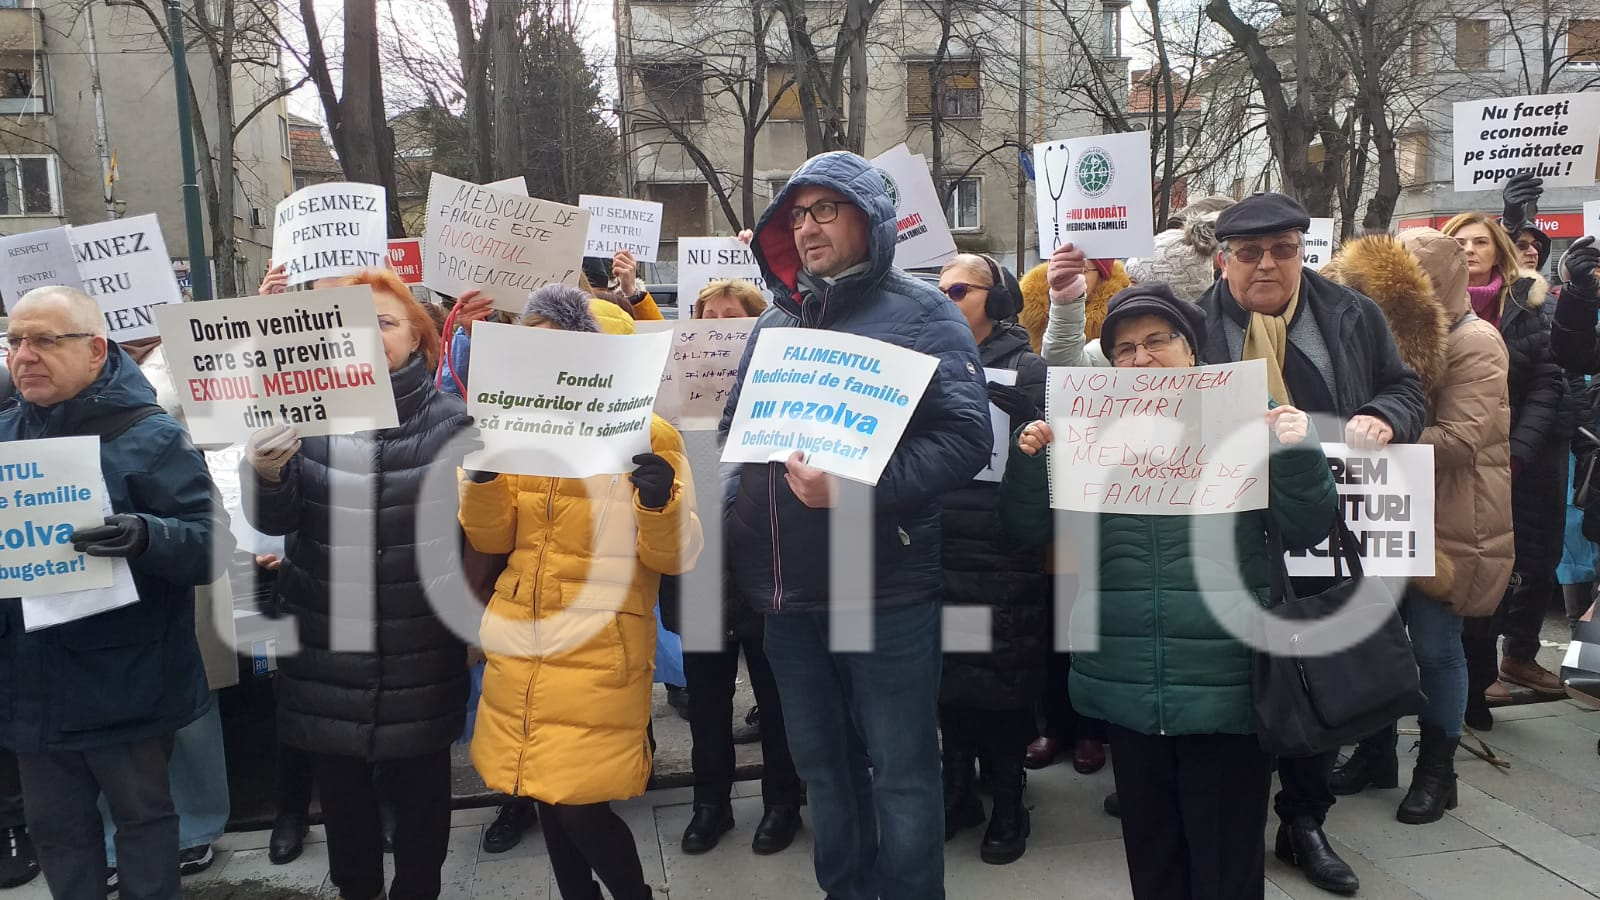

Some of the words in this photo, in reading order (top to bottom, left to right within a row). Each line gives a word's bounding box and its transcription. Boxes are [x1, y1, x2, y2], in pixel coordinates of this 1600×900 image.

[1481, 105, 1509, 121] Nu
[1480, 121, 1569, 141] economie
[1463, 149, 1484, 165] pe
[1489, 142, 1584, 160] sănătatea
[1473, 162, 1561, 185] poporului
[1564, 161, 1573, 176] !
[278, 205, 296, 227] NU
[298, 194, 378, 217] SEMNEZ
[451, 184, 546, 224] MEDICUL
[553, 208, 579, 227] DE
[588, 206, 604, 217] NU
[607, 207, 655, 223] SEMNEZ
[1066, 208, 1083, 220] #NU
[292, 221, 361, 245] PENTRU
[440, 205, 500, 231] FAMILIE
[511, 223, 552, 242] ESTE
[600, 223, 642, 237] PENTRU
[1066, 222, 1097, 231] MEDICINA
[1098, 221, 1128, 231] FAMILIEI
[1535, 218, 1559, 231] tive
[8, 242, 50, 258] RESPECT
[73, 232, 152, 263] MNEZ
[438, 224, 532, 265] AVOCATUL
[587, 239, 651, 256] FALIMENT
[1305, 238, 1329, 247] milie
[286, 249, 380, 277] ALIMENT
[388, 248, 405, 262] OP
[687, 249, 711, 265] NU
[717, 249, 757, 265] SEM
[1303, 254, 1319, 264] va
[17, 270, 57, 284] PENTRU
[82, 272, 132, 297] TRU
[189, 315, 251, 342] Dorim
[257, 305, 344, 337] venituri
[681, 333, 697, 342] SE
[708, 330, 748, 341] POATE
[193, 351, 237, 372] care
[243, 349, 268, 369] sa
[273, 333, 356, 372] prevină
[783, 346, 881, 375] FALIMENTUL
[188, 375, 259, 402] EXODUL
[262, 363, 376, 397] MEDICILOR
[556, 370, 613, 389] Fondul
[752, 368, 816, 385] Medicinei
[818, 374, 840, 388] de
[843, 376, 909, 408] familie
[1063, 370, 1119, 392] NOI
[1132, 371, 1233, 393] SUNTEM
[477, 389, 583, 412] asigurărilor
[587, 400, 605, 413] de
[607, 395, 654, 413] sănătate
[243, 405, 275, 429] din
[479, 413, 500, 430] să
[505, 414, 574, 436] rămână
[578, 422, 593, 437] la
[596, 417, 645, 437] sănătate!
[751, 399, 774, 419] nu
[779, 399, 879, 436] rezolva
[741, 430, 795, 448] Deficitul
[796, 431, 869, 460] bugetar!
[1067, 424, 1099, 445] DE
[1072, 440, 1210, 467] MEDICUL
[1131, 466, 1202, 480] NOSTRU
[1217, 463, 1248, 479] DE
[1326, 457, 1388, 485] REM
[13, 485, 91, 508] familie
[1083, 480, 1221, 507] FAMILIE
[1338, 494, 1411, 522] ITURI
[1408, 531, 1416, 558] !
[256, 658, 267, 671] RO
